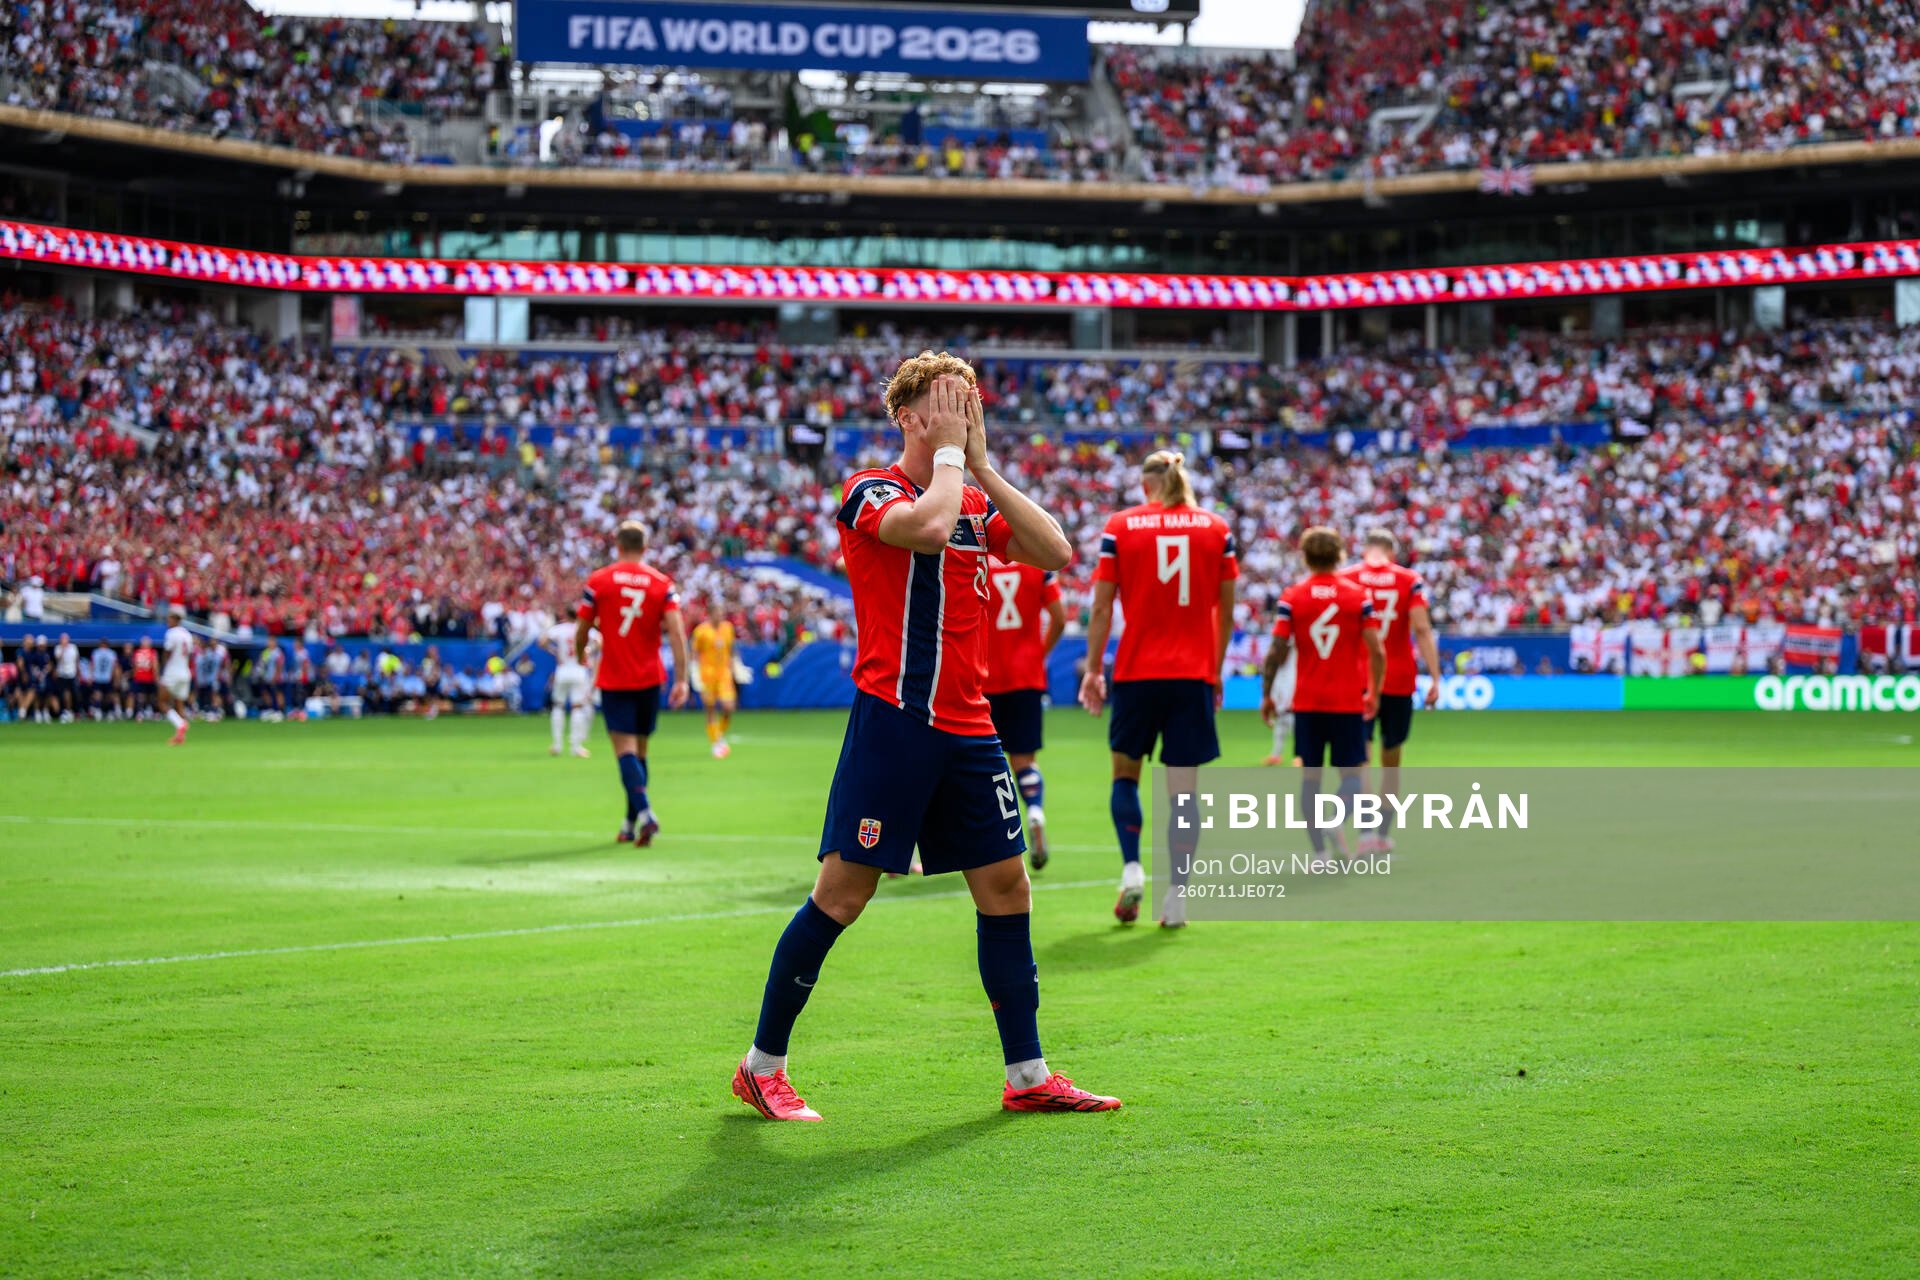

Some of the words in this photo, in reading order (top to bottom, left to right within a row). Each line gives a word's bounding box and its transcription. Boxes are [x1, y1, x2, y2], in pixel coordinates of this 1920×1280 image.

[568, 15, 658, 49] FIFA
[660, 18, 809, 55] WORLD
[813, 23, 895, 58] CUP
[899, 26, 1041, 63] 2026
[1156, 534, 1191, 607] 9
[618, 586, 646, 637] 7
[992, 571, 1023, 630] 8
[1309, 602, 1340, 659] 6
[1754, 675, 1920, 711] aramco
[992, 771, 1018, 820] 2
